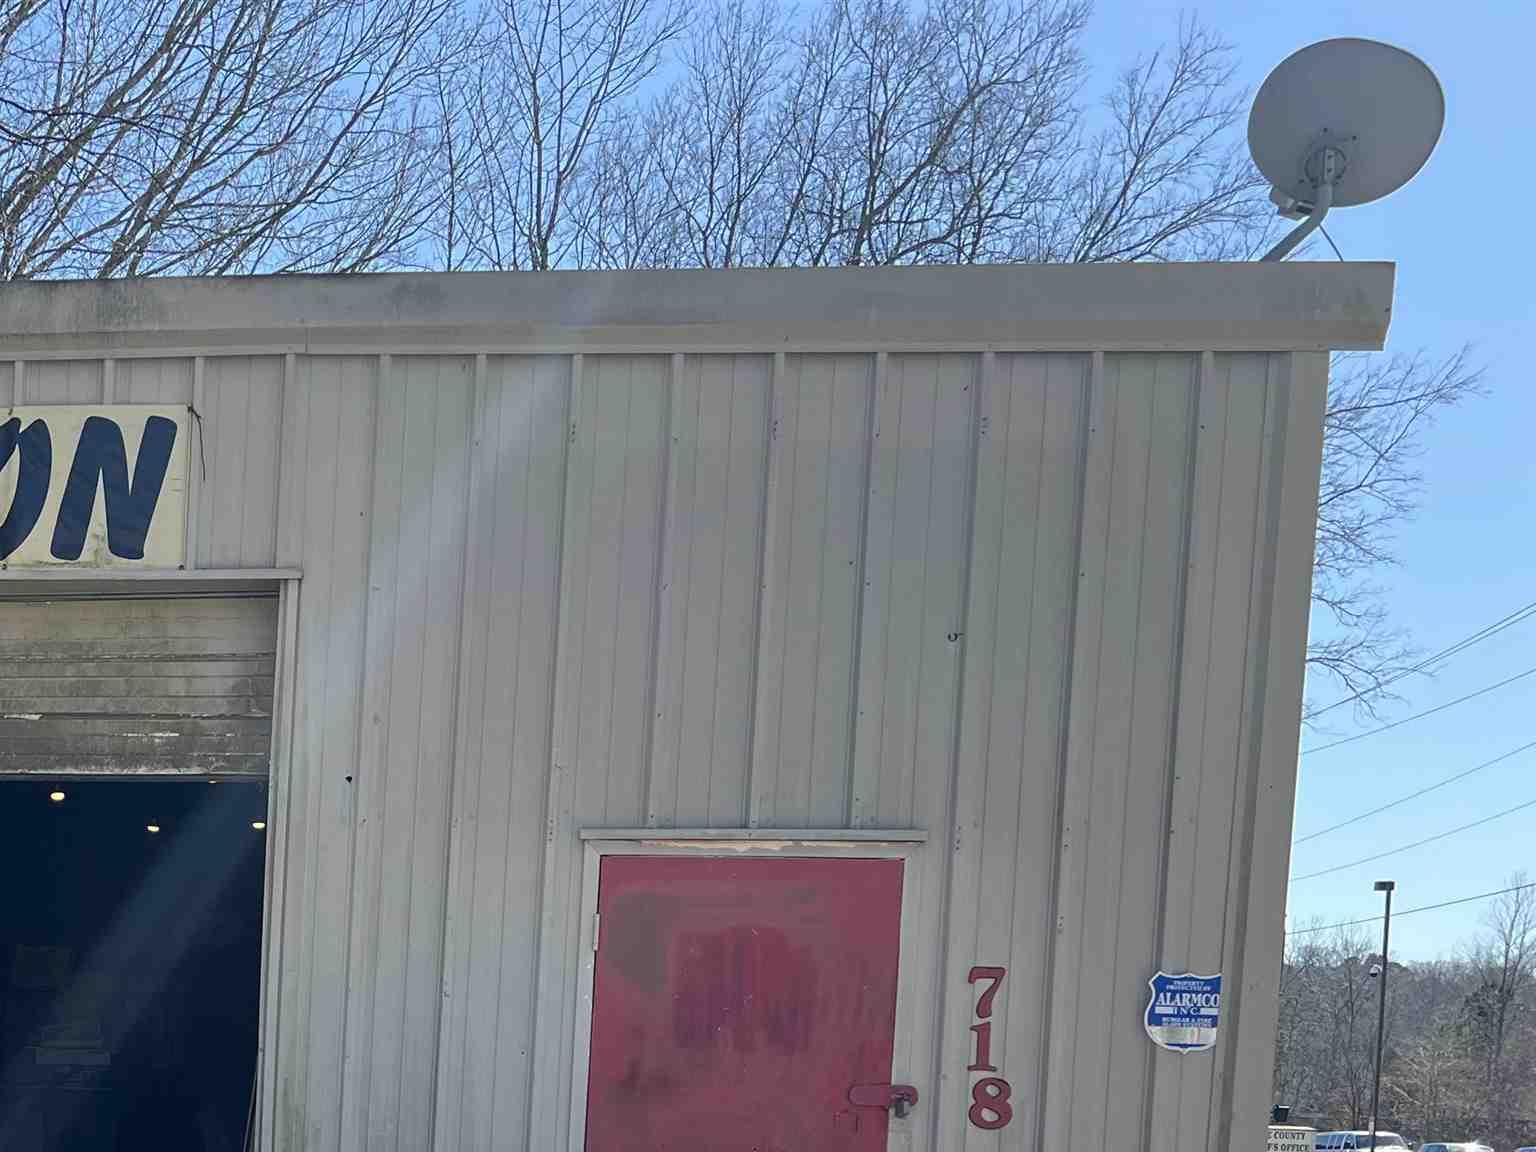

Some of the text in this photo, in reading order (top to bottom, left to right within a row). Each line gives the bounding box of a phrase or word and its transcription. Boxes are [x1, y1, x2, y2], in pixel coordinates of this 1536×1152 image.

[1156, 993, 1219, 1007] ALARMCO
[968, 966, 1013, 1130] 718
[1274, 1131, 1306, 1140] COUNTY
[1280, 1143, 1310, 1152] OFFICE
